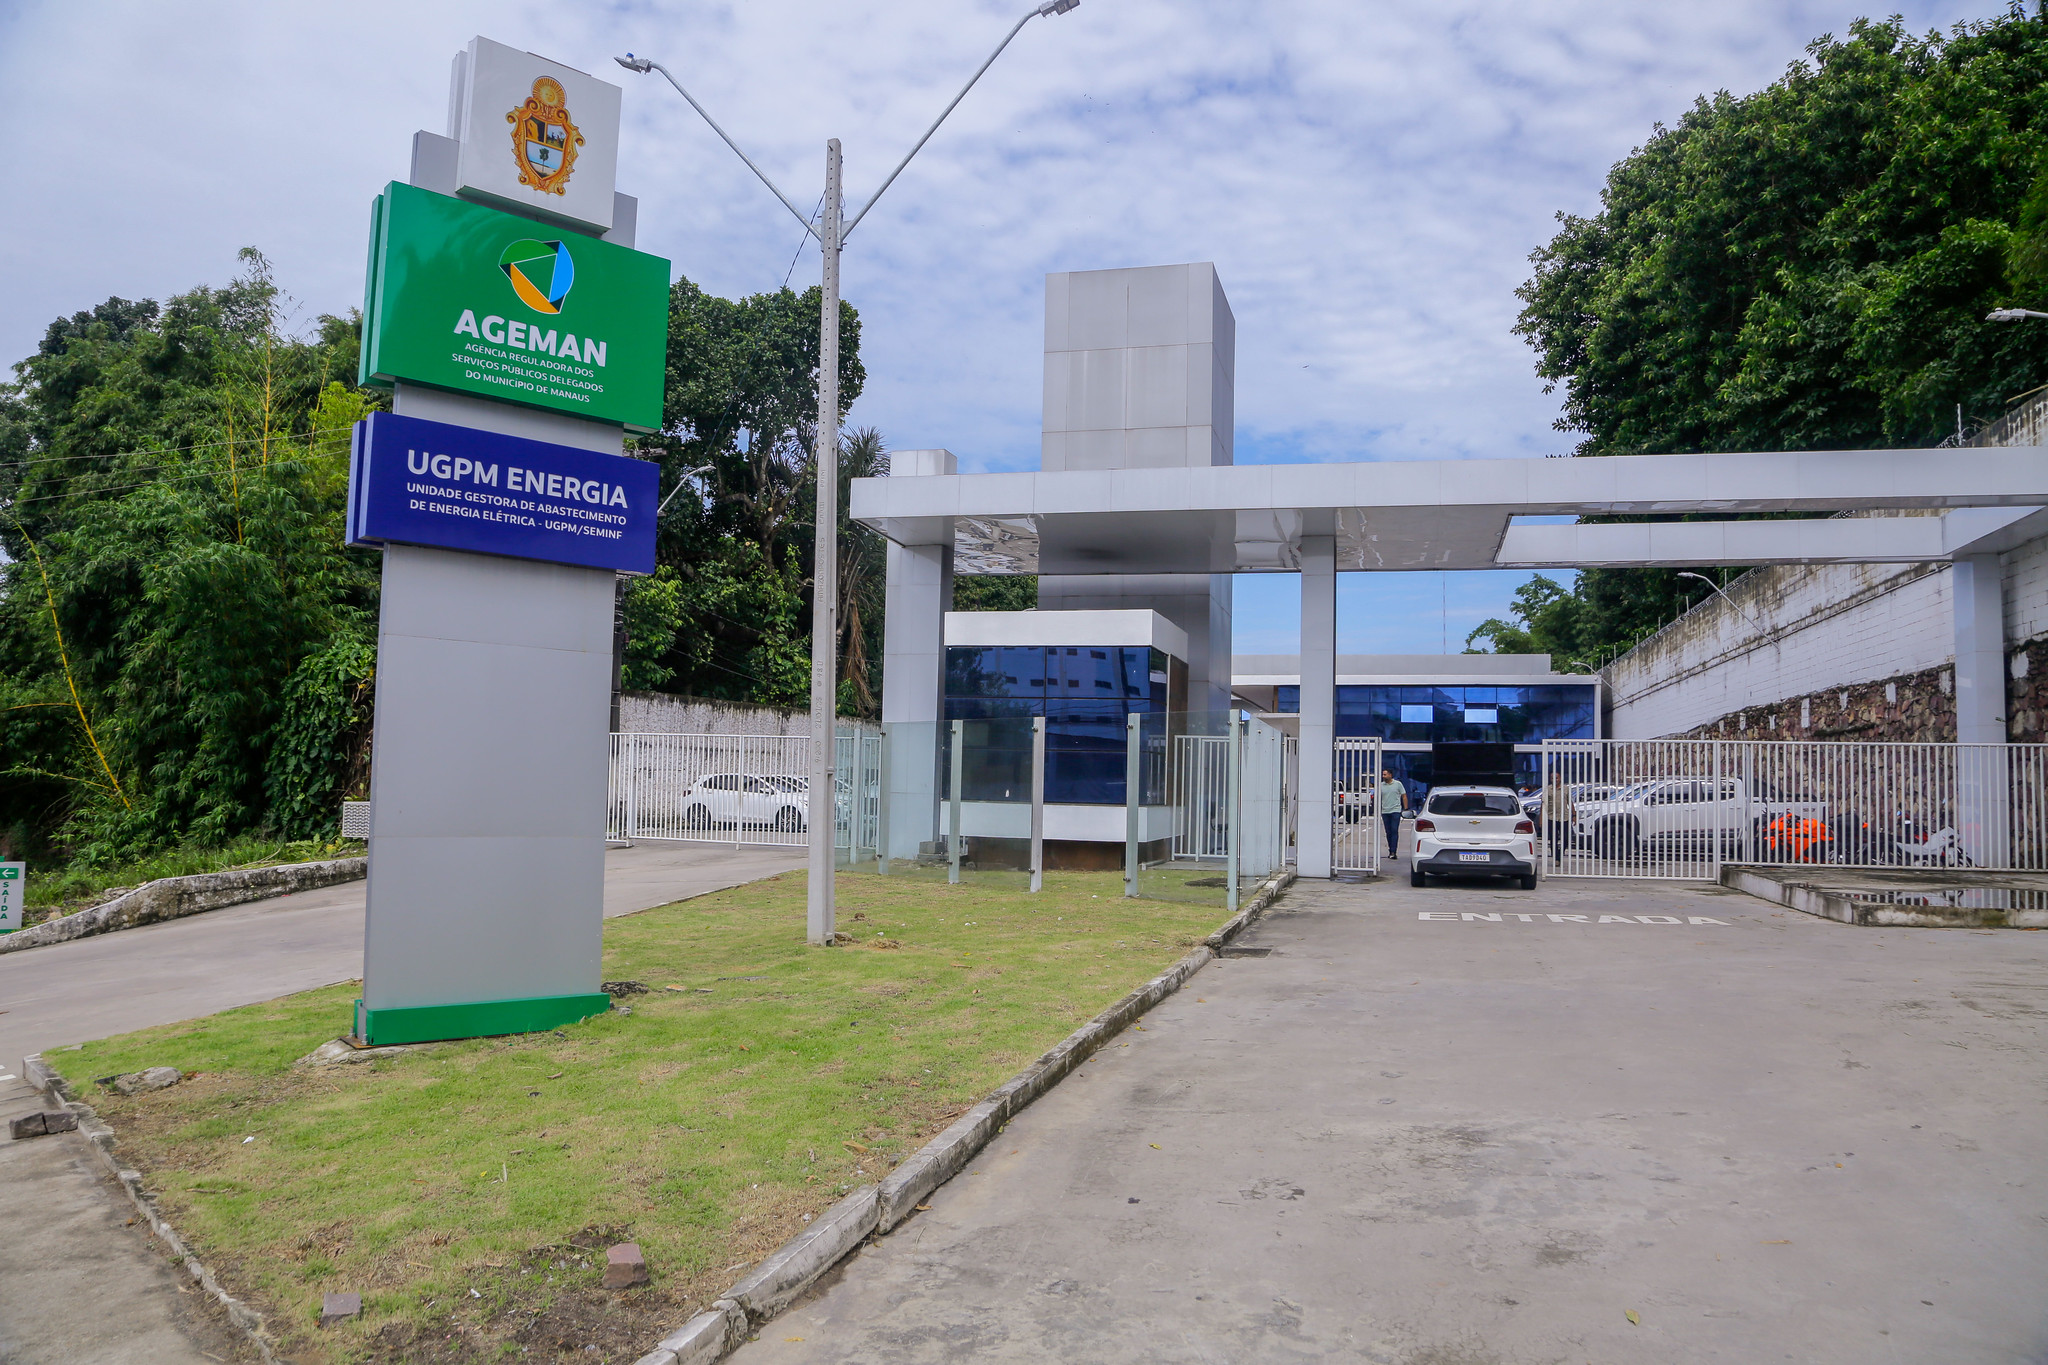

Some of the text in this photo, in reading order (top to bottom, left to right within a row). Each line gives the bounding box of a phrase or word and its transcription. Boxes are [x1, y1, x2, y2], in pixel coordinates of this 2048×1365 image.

[453, 308, 607, 367] AGEMAN
[451, 353, 604, 393] SERVIÇOS PÚBLICOS DELEGADOS
[465, 342, 594, 378] AGÊNCIA REGULADORA DOS
[465, 370, 590, 403] DO MUNICÍPIO DE MANAUS
[407, 449, 629, 509] UGPM ENERGIA
[406, 482, 627, 526] UNIDADE GESTORA DE ABASTECIMENTO
[409, 499, 426, 511] DE
[429, 502, 481, 519] ENERGIA
[482, 509, 536, 527] ELÉTRICA
[544, 519, 623, 540] UGPM/SEMINF
[0, 881, 9, 919] SAÍDA
[1417, 911, 1732, 926] ENTRADA
